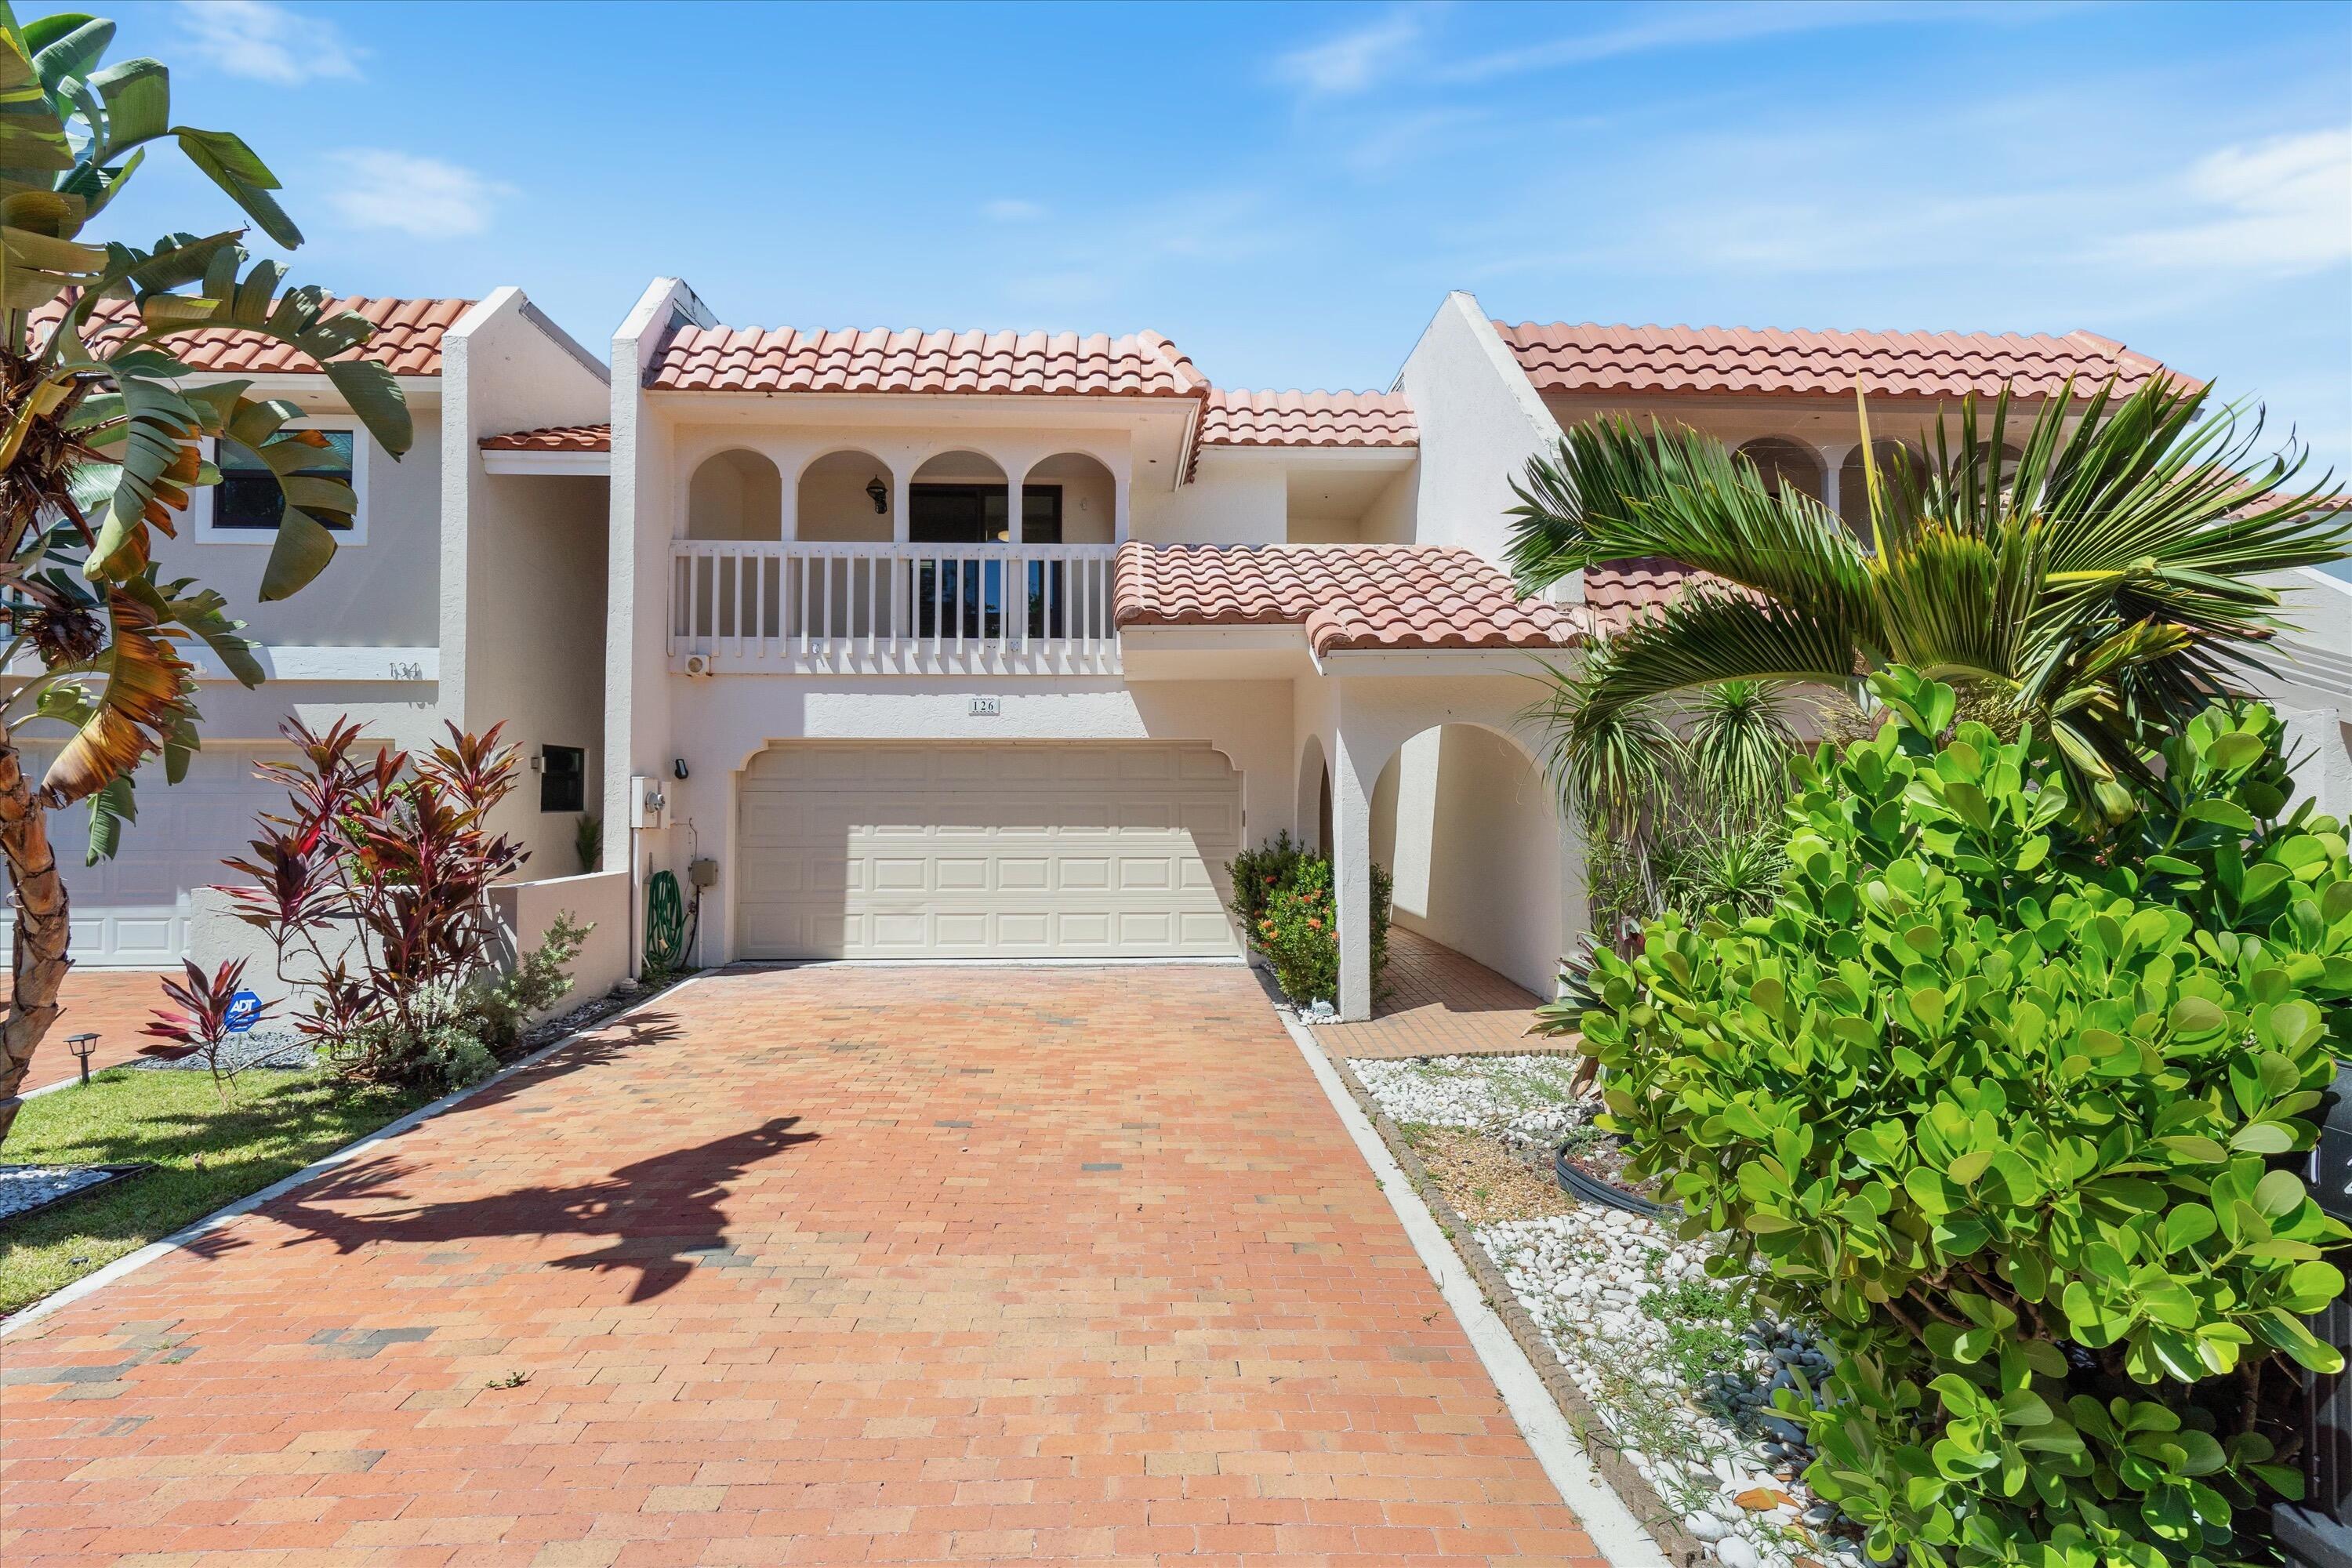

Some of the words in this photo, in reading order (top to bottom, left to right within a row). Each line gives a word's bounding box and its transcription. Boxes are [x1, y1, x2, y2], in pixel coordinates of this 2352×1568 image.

[390, 662, 419, 677] 134
[973, 701, 993, 710] 126
[230, 999, 256, 1013] ADT
